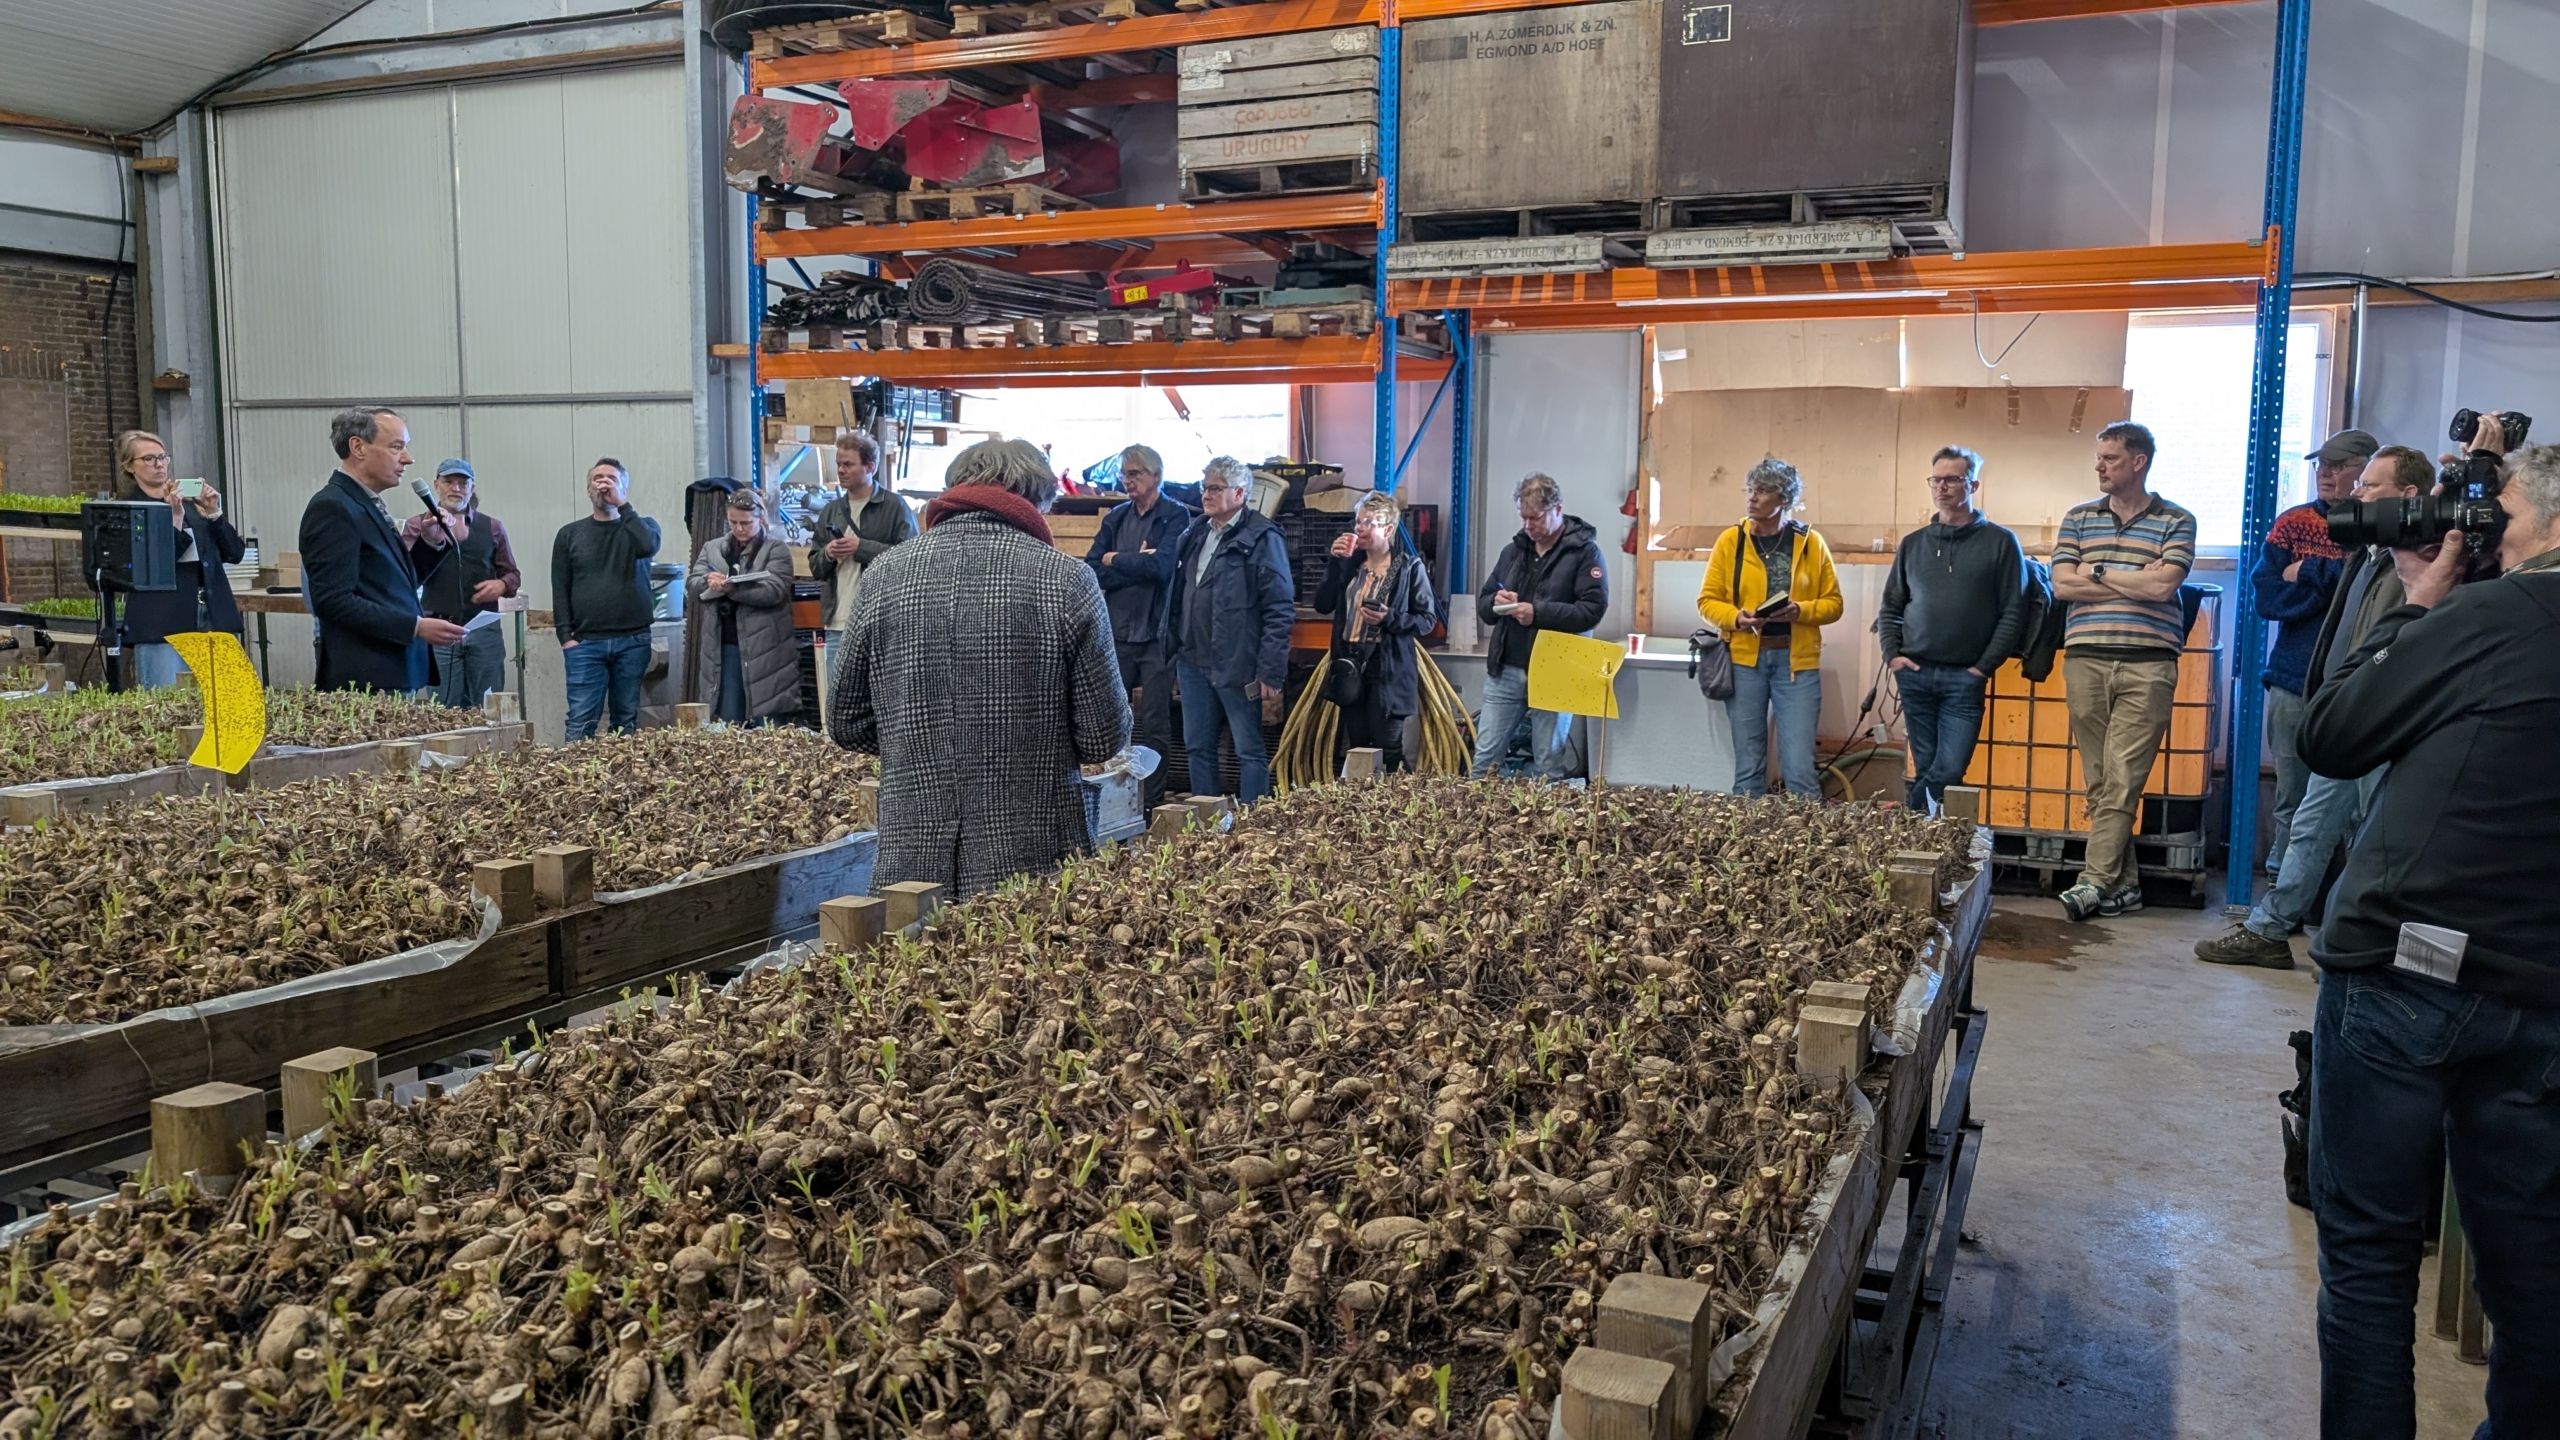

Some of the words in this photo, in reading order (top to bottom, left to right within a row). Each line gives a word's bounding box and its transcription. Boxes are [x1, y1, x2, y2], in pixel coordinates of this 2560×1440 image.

[1499, 21, 1576, 41] ZOMERDIJK
[1580, 21, 1592, 33] &
[1476, 43, 1538, 60] EGMOND
[1541, 41, 1565, 54] A/D
[1569, 37, 1606, 52] HOEF
[1221, 134, 1312, 158] URUGUAY
